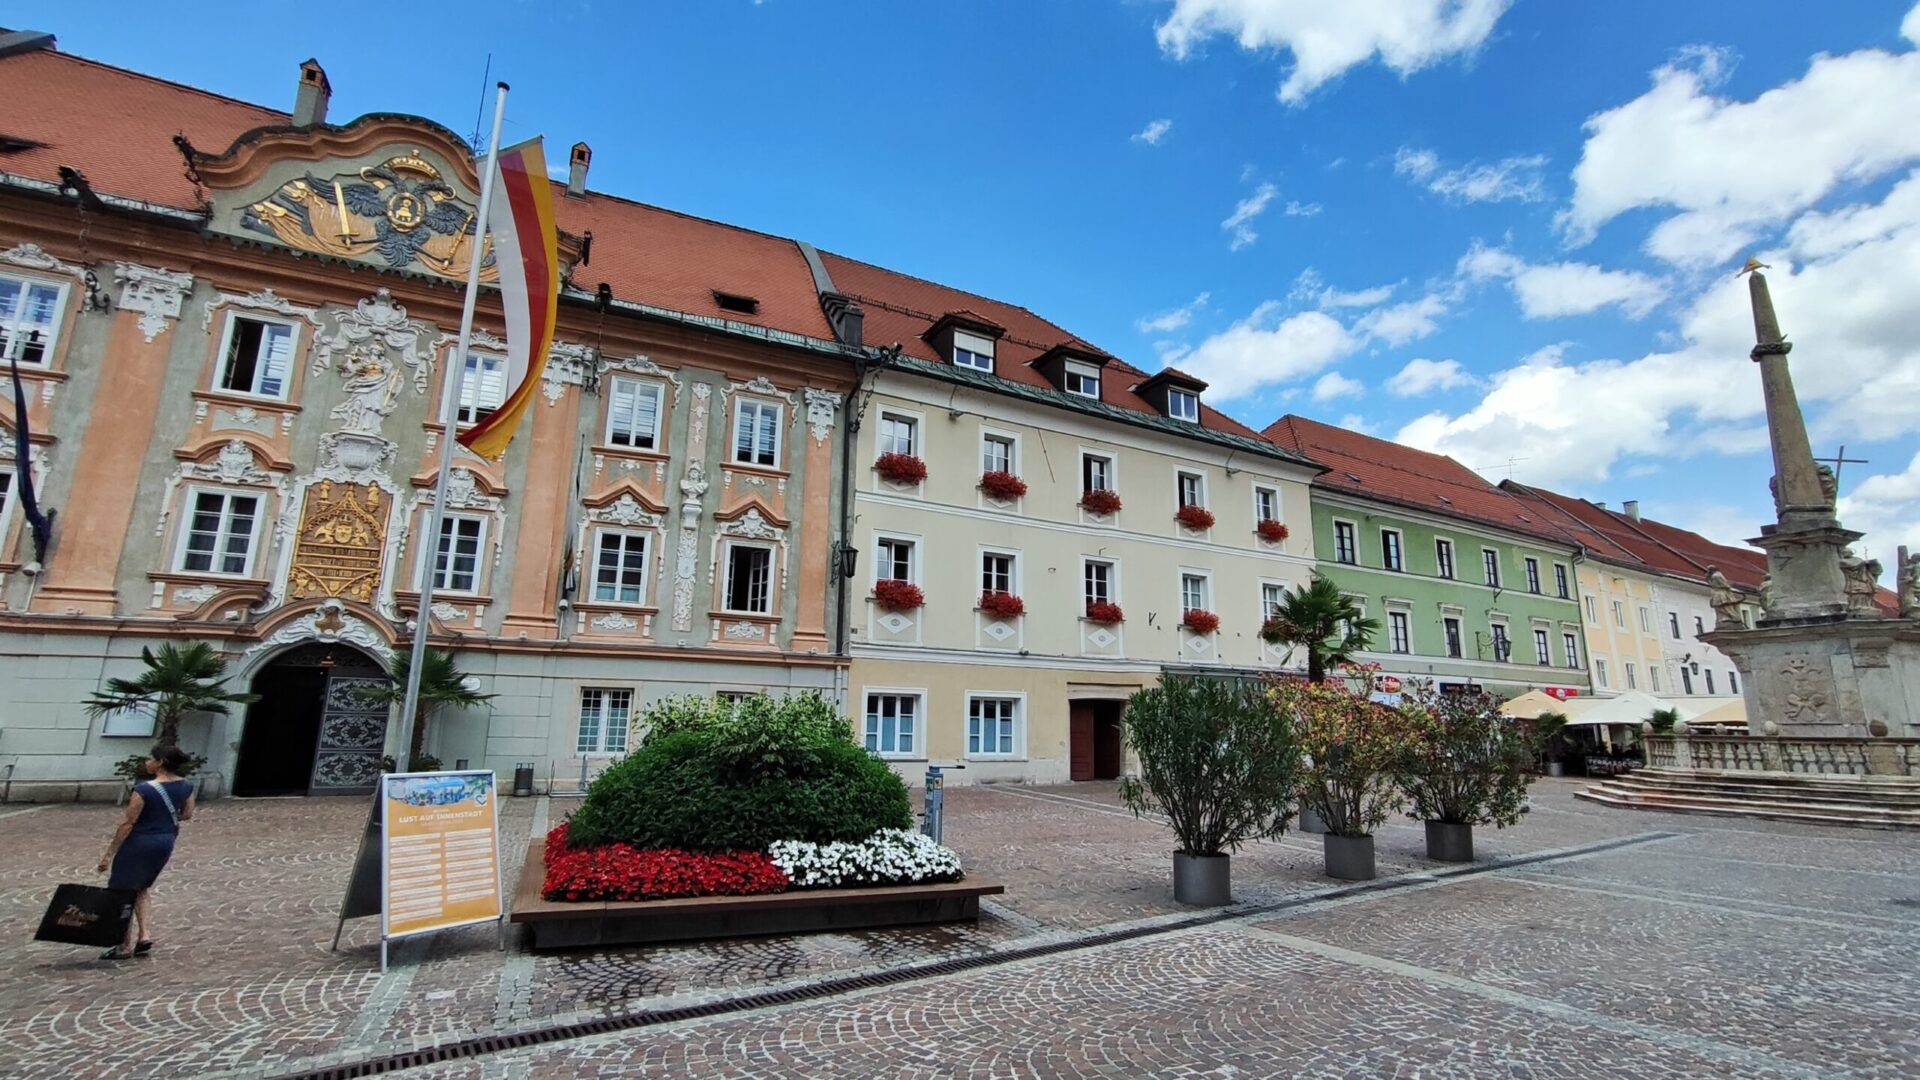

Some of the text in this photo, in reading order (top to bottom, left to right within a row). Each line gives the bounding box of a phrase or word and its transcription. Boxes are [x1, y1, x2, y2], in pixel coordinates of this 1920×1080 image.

[399, 815, 419, 823] LUST
[420, 813, 435, 822] AUF
[436, 810, 482, 820] INNENSTADT
